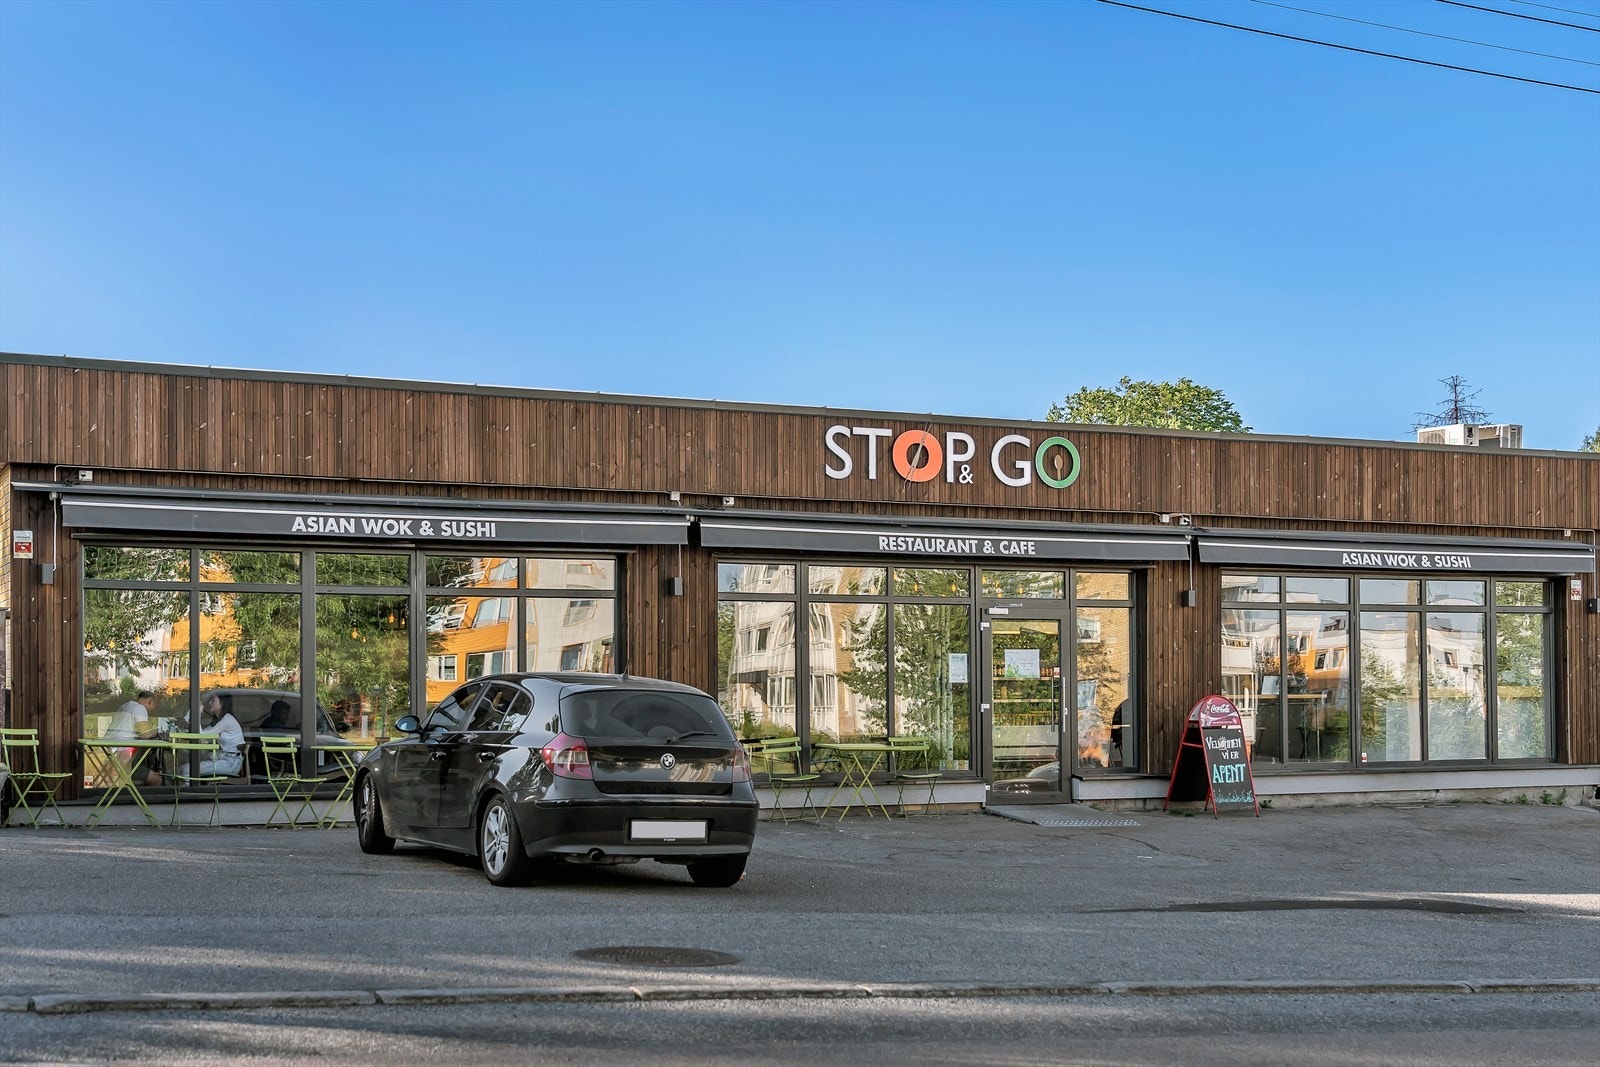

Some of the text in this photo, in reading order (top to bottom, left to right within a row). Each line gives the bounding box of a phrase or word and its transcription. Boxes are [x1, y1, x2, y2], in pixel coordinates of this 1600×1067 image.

[825, 425, 1081, 489] STOP & GO
[291, 516, 496, 538] ASIAN WOK & SUSHI
[879, 536, 1036, 555] RESTAURANT & CAFE
[1342, 553, 1472, 568] ASIAN WOK & SUSHI
